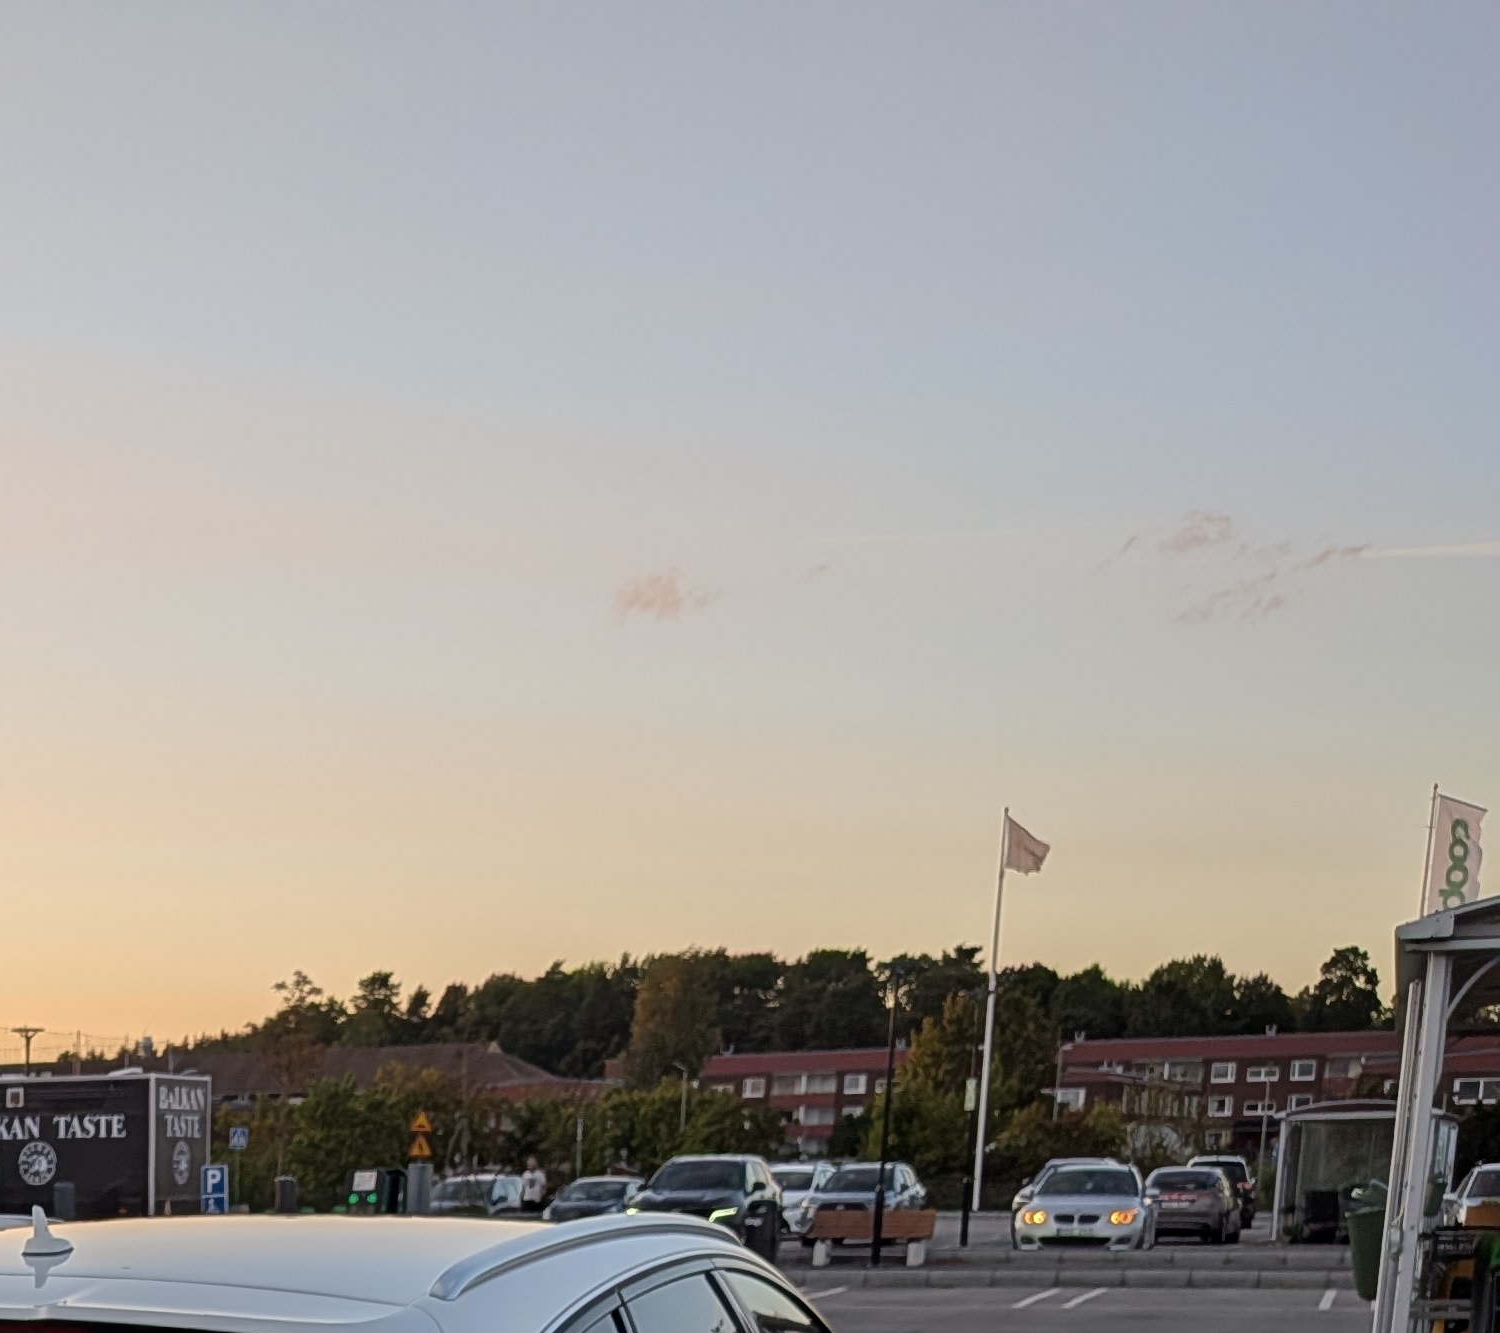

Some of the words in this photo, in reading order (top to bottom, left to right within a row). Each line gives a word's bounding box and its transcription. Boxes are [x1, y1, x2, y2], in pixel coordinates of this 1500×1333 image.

[53, 1114, 127, 1139] TASTE
[164, 1114, 202, 1138] TASTE
[206, 1169, 222, 1194] P
